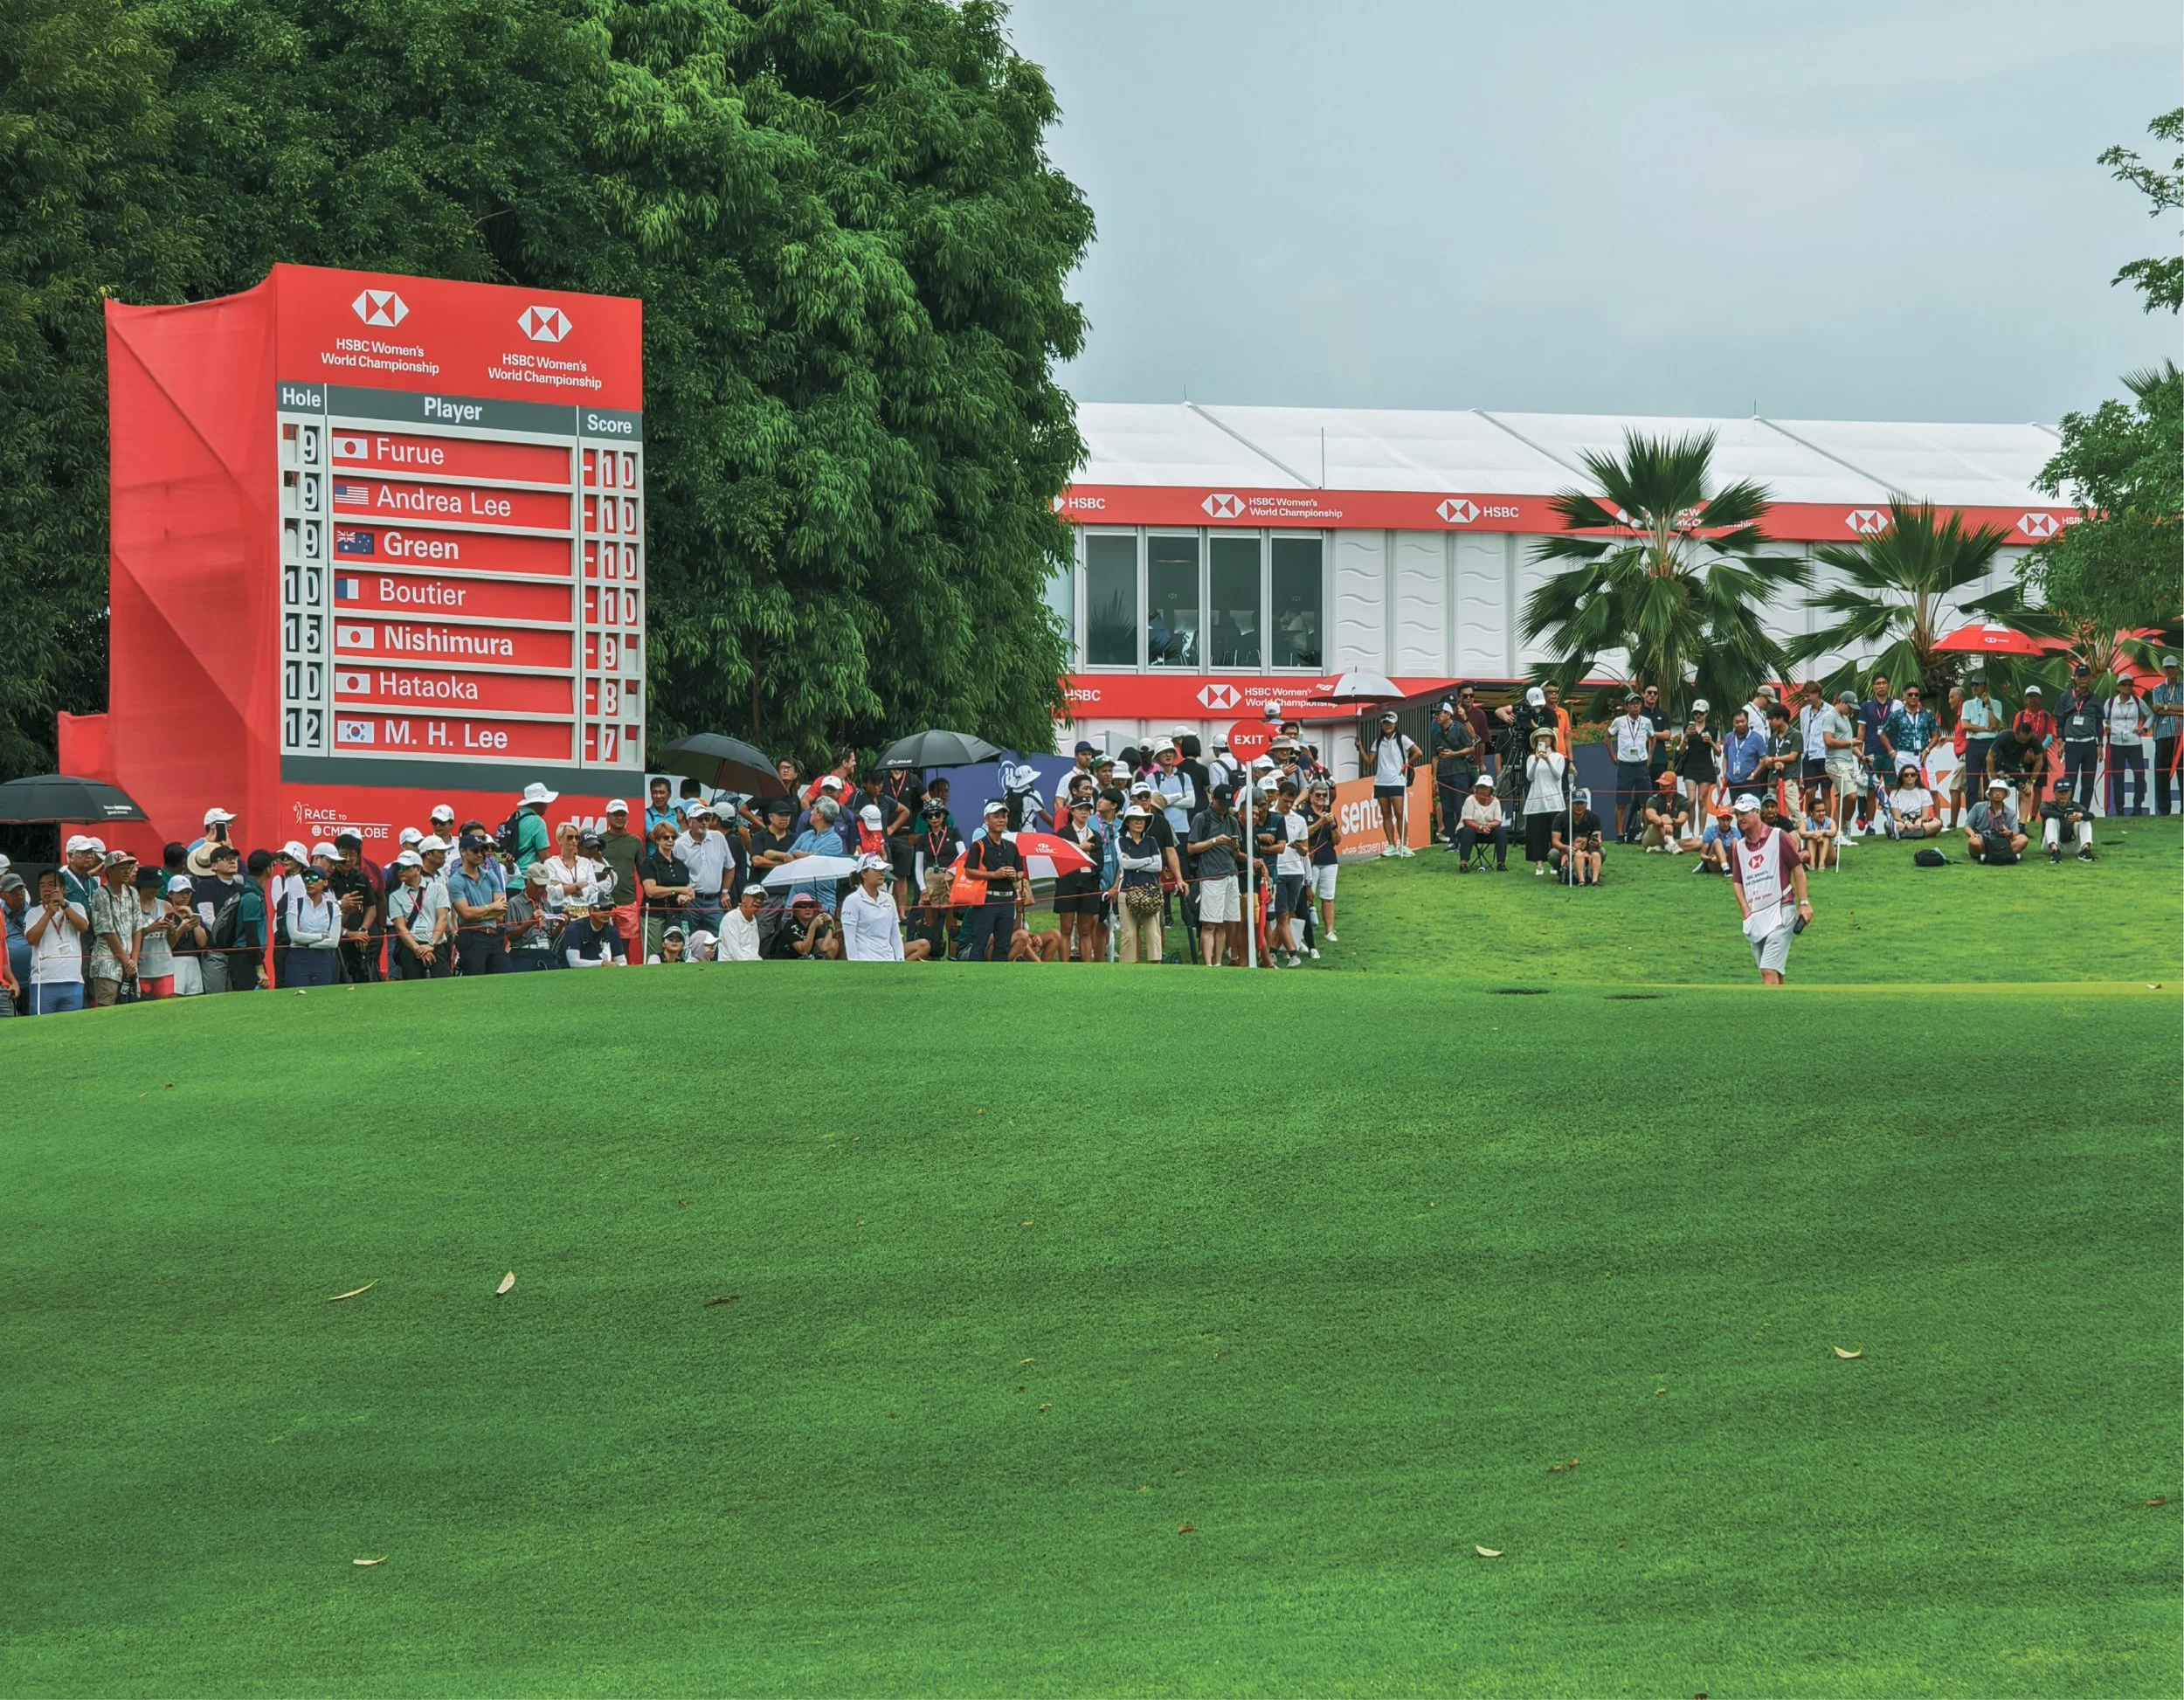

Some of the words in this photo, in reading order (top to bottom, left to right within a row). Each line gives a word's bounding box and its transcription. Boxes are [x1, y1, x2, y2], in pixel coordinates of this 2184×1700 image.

[335, 338, 370, 352] HSBC
[371, 342, 424, 356] Women's
[321, 352, 357, 366] World
[358, 356, 439, 375] Championship
[502, 353, 535, 367] HSBC
[536, 356, 587, 371] Women's
[488, 367, 523, 382] World
[524, 370, 602, 390] Championship
[282, 388, 321, 407] Hole
[424, 397, 482, 423] Player
[587, 415, 632, 433] Score
[303, 431, 317, 462] 9
[377, 439, 444, 465] Furue
[304, 478, 318, 509] 9
[377, 486, 462, 513] Andrea
[471, 493, 511, 516] Lee
[1068, 498, 1105, 509] HSBC
[1248, 498, 1276, 507] HSBC
[1277, 498, 1317, 508] Women's
[1250, 508, 1277, 517] World
[1279, 508, 1343, 520] Championship
[1483, 506, 1519, 518] HSBC
[305, 524, 318, 557] 9
[384, 533, 459, 559] Green
[286, 570, 319, 604] 10
[379, 579, 467, 605] Boutier
[286, 618, 319, 650] 15
[384, 625, 513, 655] Nishimura
[585, 637, 616, 668] -9
[286, 666, 319, 698] 10
[379, 673, 478, 700] Hataoka
[585, 683, 617, 713] -8
[1065, 689, 1101, 701] HSBC
[286, 713, 319, 745] 12
[385, 721, 417, 744] M.
[428, 722, 453, 746] H.
[465, 725, 508, 749] Lee
[585, 729, 614, 758] -7
[1234, 736, 1264, 744] EXIT
[304, 809, 335, 819] RACE
[356, 826, 388, 839] LOBE
[1342, 846, 1357, 854] where
[1358, 842, 1380, 853] discovery
